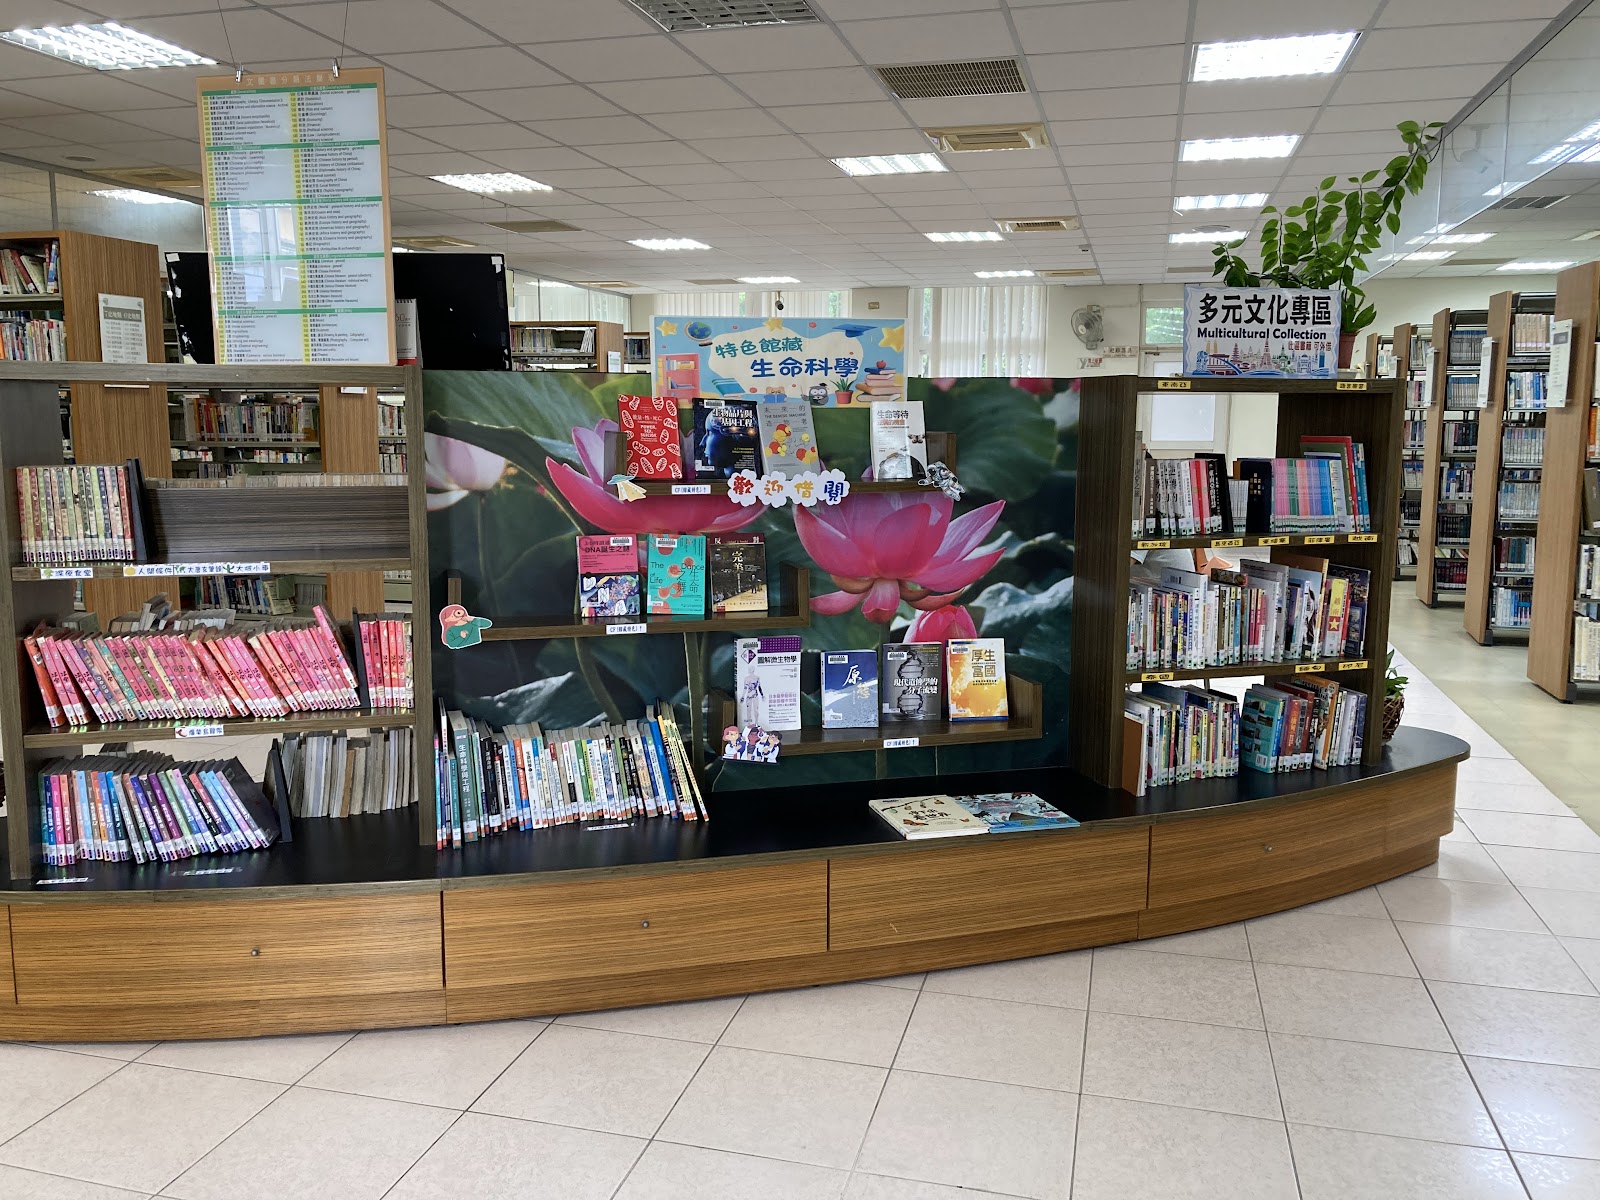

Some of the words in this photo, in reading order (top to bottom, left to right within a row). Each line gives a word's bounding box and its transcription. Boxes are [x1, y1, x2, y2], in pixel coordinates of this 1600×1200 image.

[1198, 293, 1332, 326] 多元文化專區
[1198, 328, 1270, 339] Multicultural
[1272, 328, 1326, 340] Collection
[716, 336, 803, 358] 特色館藏
[750, 356, 858, 378] 生命科學
[733, 475, 844, 502] 歡迎借閱
[681, 563, 704, 571] Dance
[676, 570, 686, 593] 之舞
[690, 569, 699, 593] 生命
[758, 656, 797, 664] 圖解微生物學
[972, 649, 995, 661] 厚生
